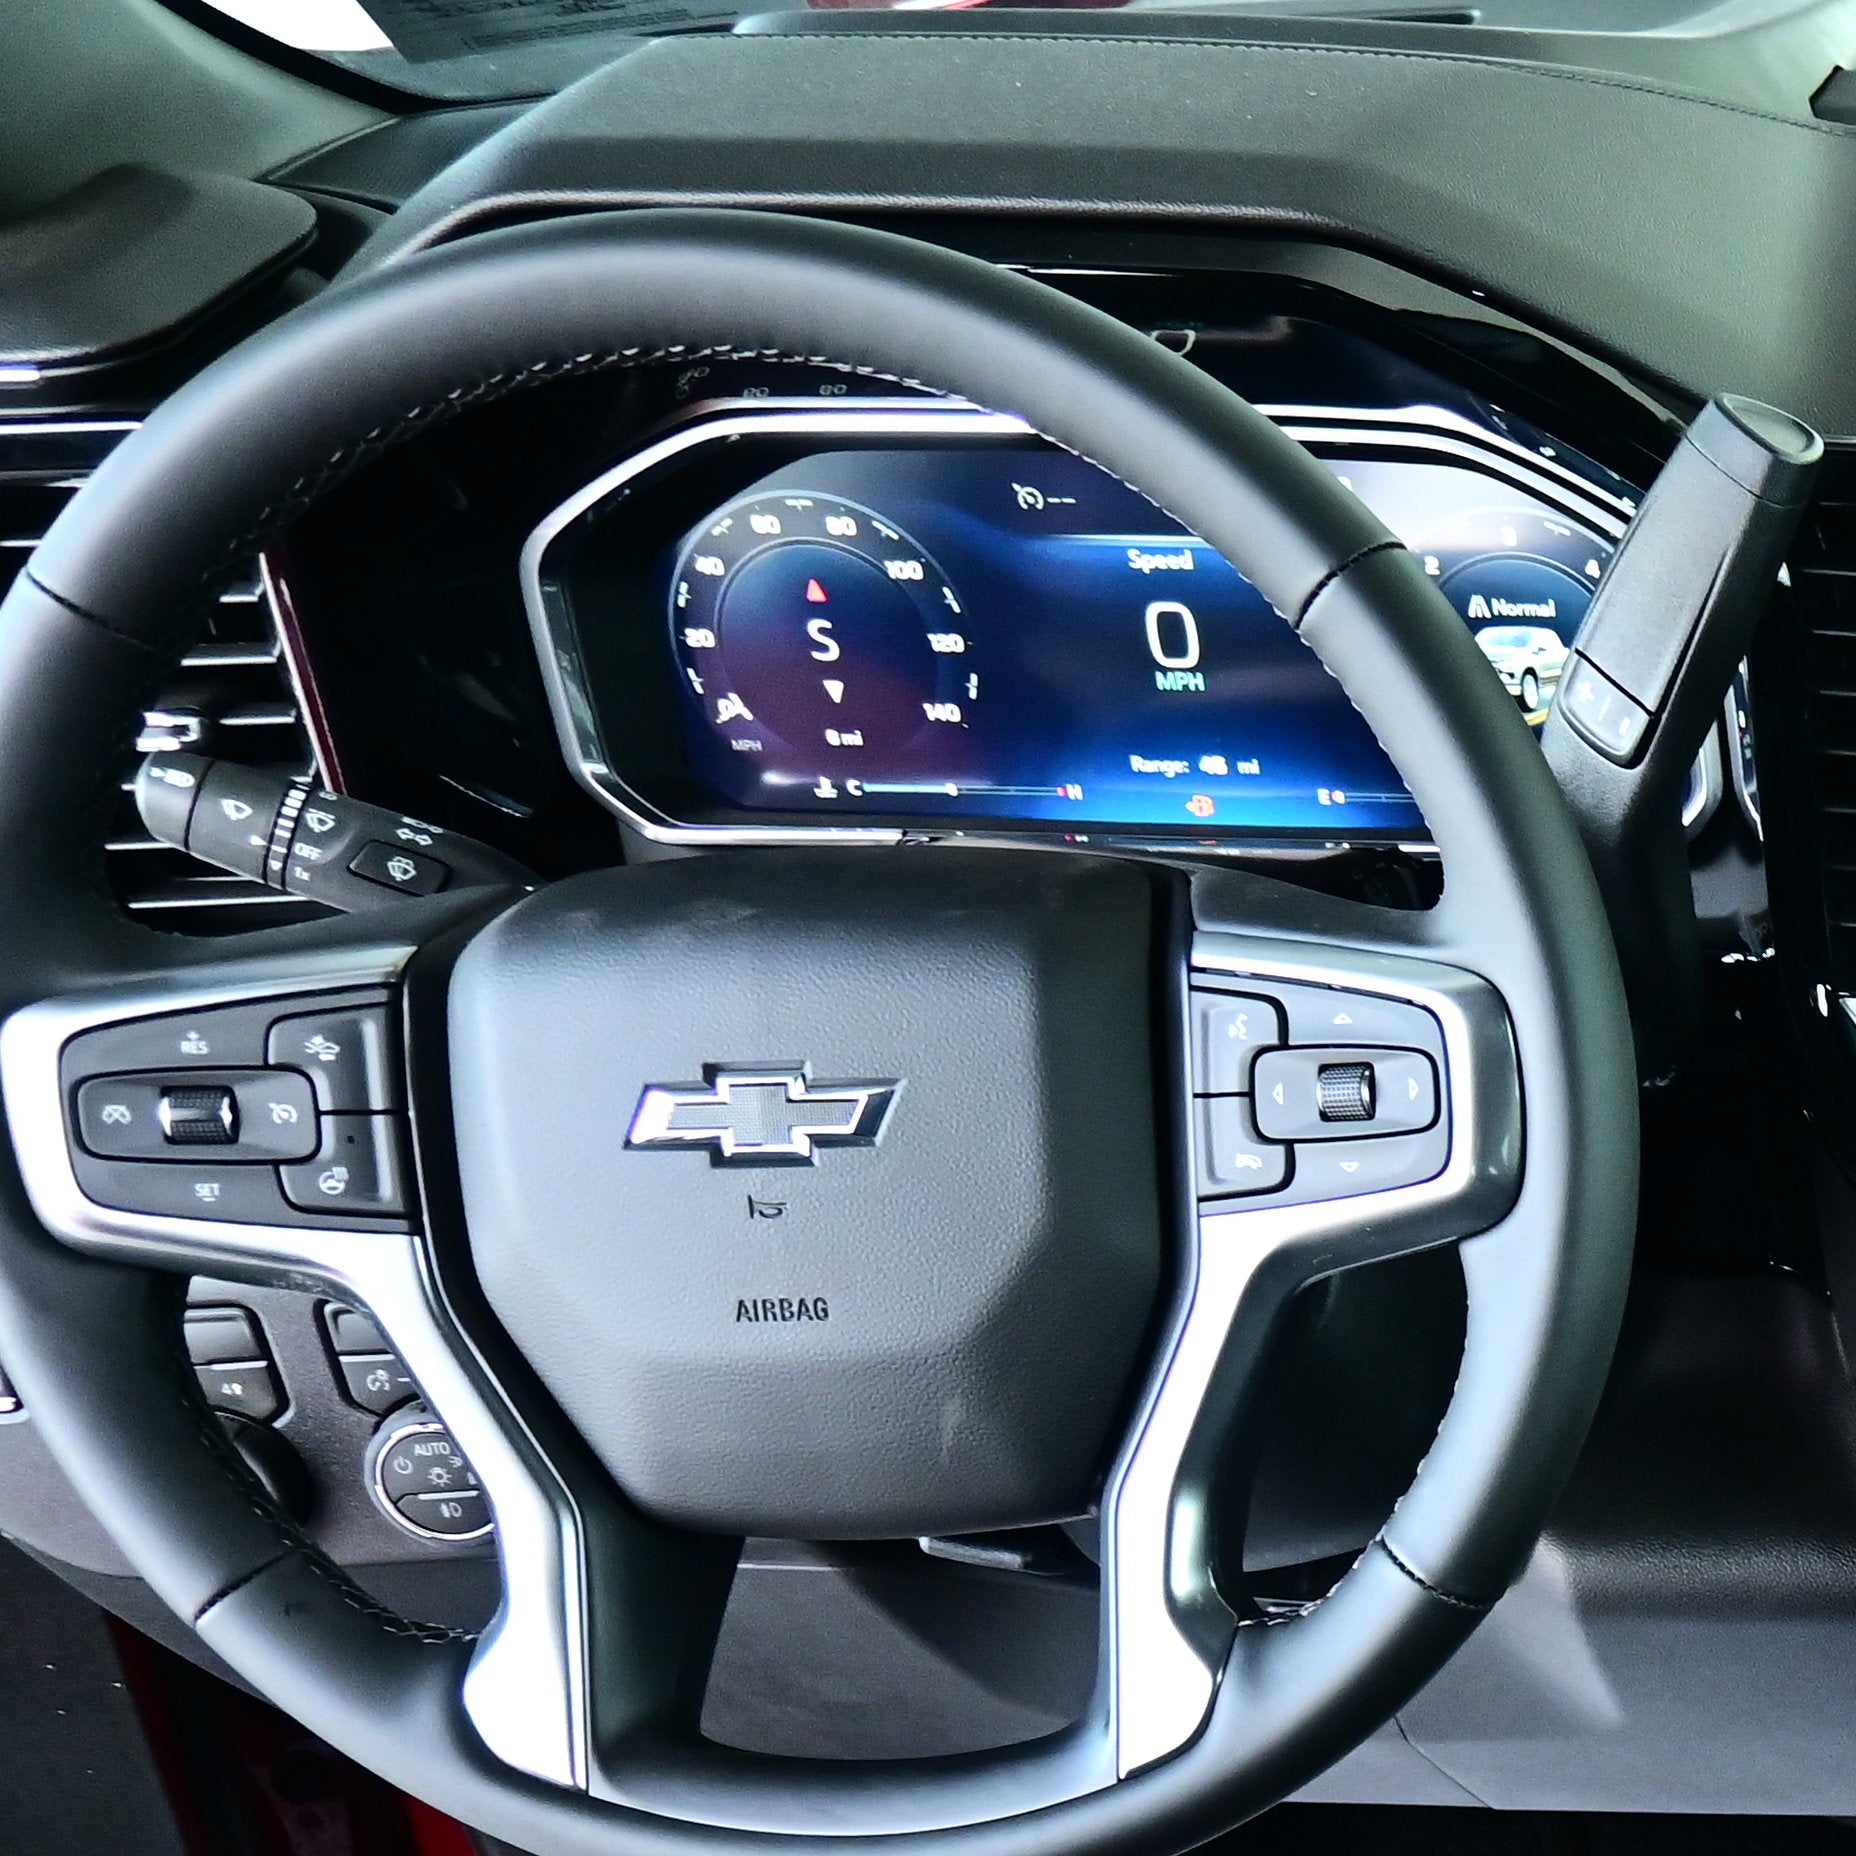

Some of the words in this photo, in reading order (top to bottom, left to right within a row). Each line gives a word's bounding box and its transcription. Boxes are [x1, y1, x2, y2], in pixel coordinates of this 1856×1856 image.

[695, 556, 725, 577] 40
[884, 560, 924, 581] 100
[1127, 549, 1194, 574] Speed
[1424, 556, 1441, 576] 2
[1491, 597, 1557, 619] Normal
[684, 628, 716, 649] 20
[806, 618, 840, 662] S
[927, 633, 965, 654] 120
[1145, 601, 1200, 670] 0
[1155, 671, 1206, 692] MPH
[922, 703, 961, 723] 140
[731, 739, 763, 752] MPH
[1130, 755, 1190, 777] Range:
[1237, 758, 1260, 776] mi
[294, 842, 323, 860] OFF
[180, 1040, 209, 1055] RES
[195, 1183, 220, 1197] SET
[736, 1296, 829, 1322] AIRBAG
[414, 1442, 450, 1457] AUTO
